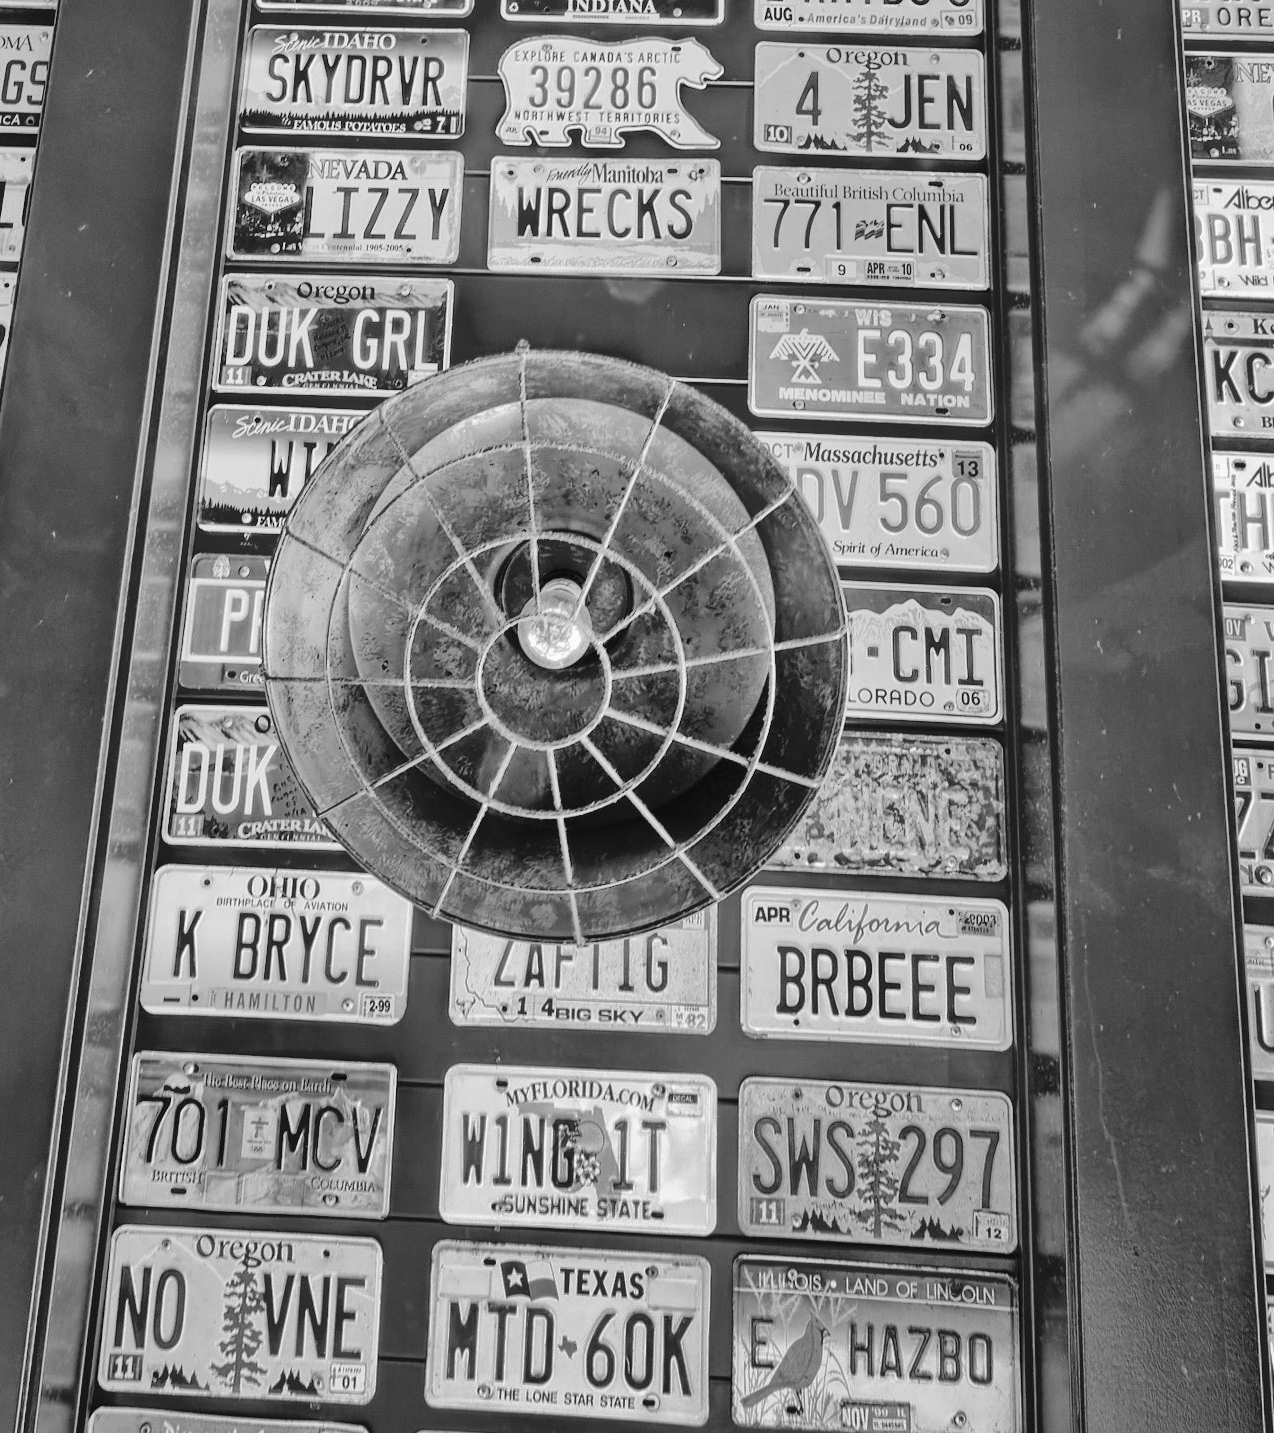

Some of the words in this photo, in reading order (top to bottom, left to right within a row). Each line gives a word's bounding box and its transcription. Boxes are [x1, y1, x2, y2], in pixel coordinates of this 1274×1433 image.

[266, 53, 445, 107] SKYDRVR
[529, 65, 658, 110] 39286
[514, 111, 591, 124] NORTHWEST
[599, 112, 681, 125] TERRITORIES
[515, 188, 694, 240] WRECKS
[855, 329, 975, 391] E334
[779, 387, 886, 404] MENOMINEE
[901, 393, 970, 408] NATION
[174, 916, 202, 979] K
[233, 911, 384, 986] BRYCE
[222, 991, 316, 1013] HAMILTON
[776, 948, 977, 1024] BRBEEE
[138, 1096, 229, 1168] 701
[276, 1105, 382, 1175] MCV
[503, 1195, 593, 1218] SUNSHINE
[598, 1198, 652, 1220] STATE
